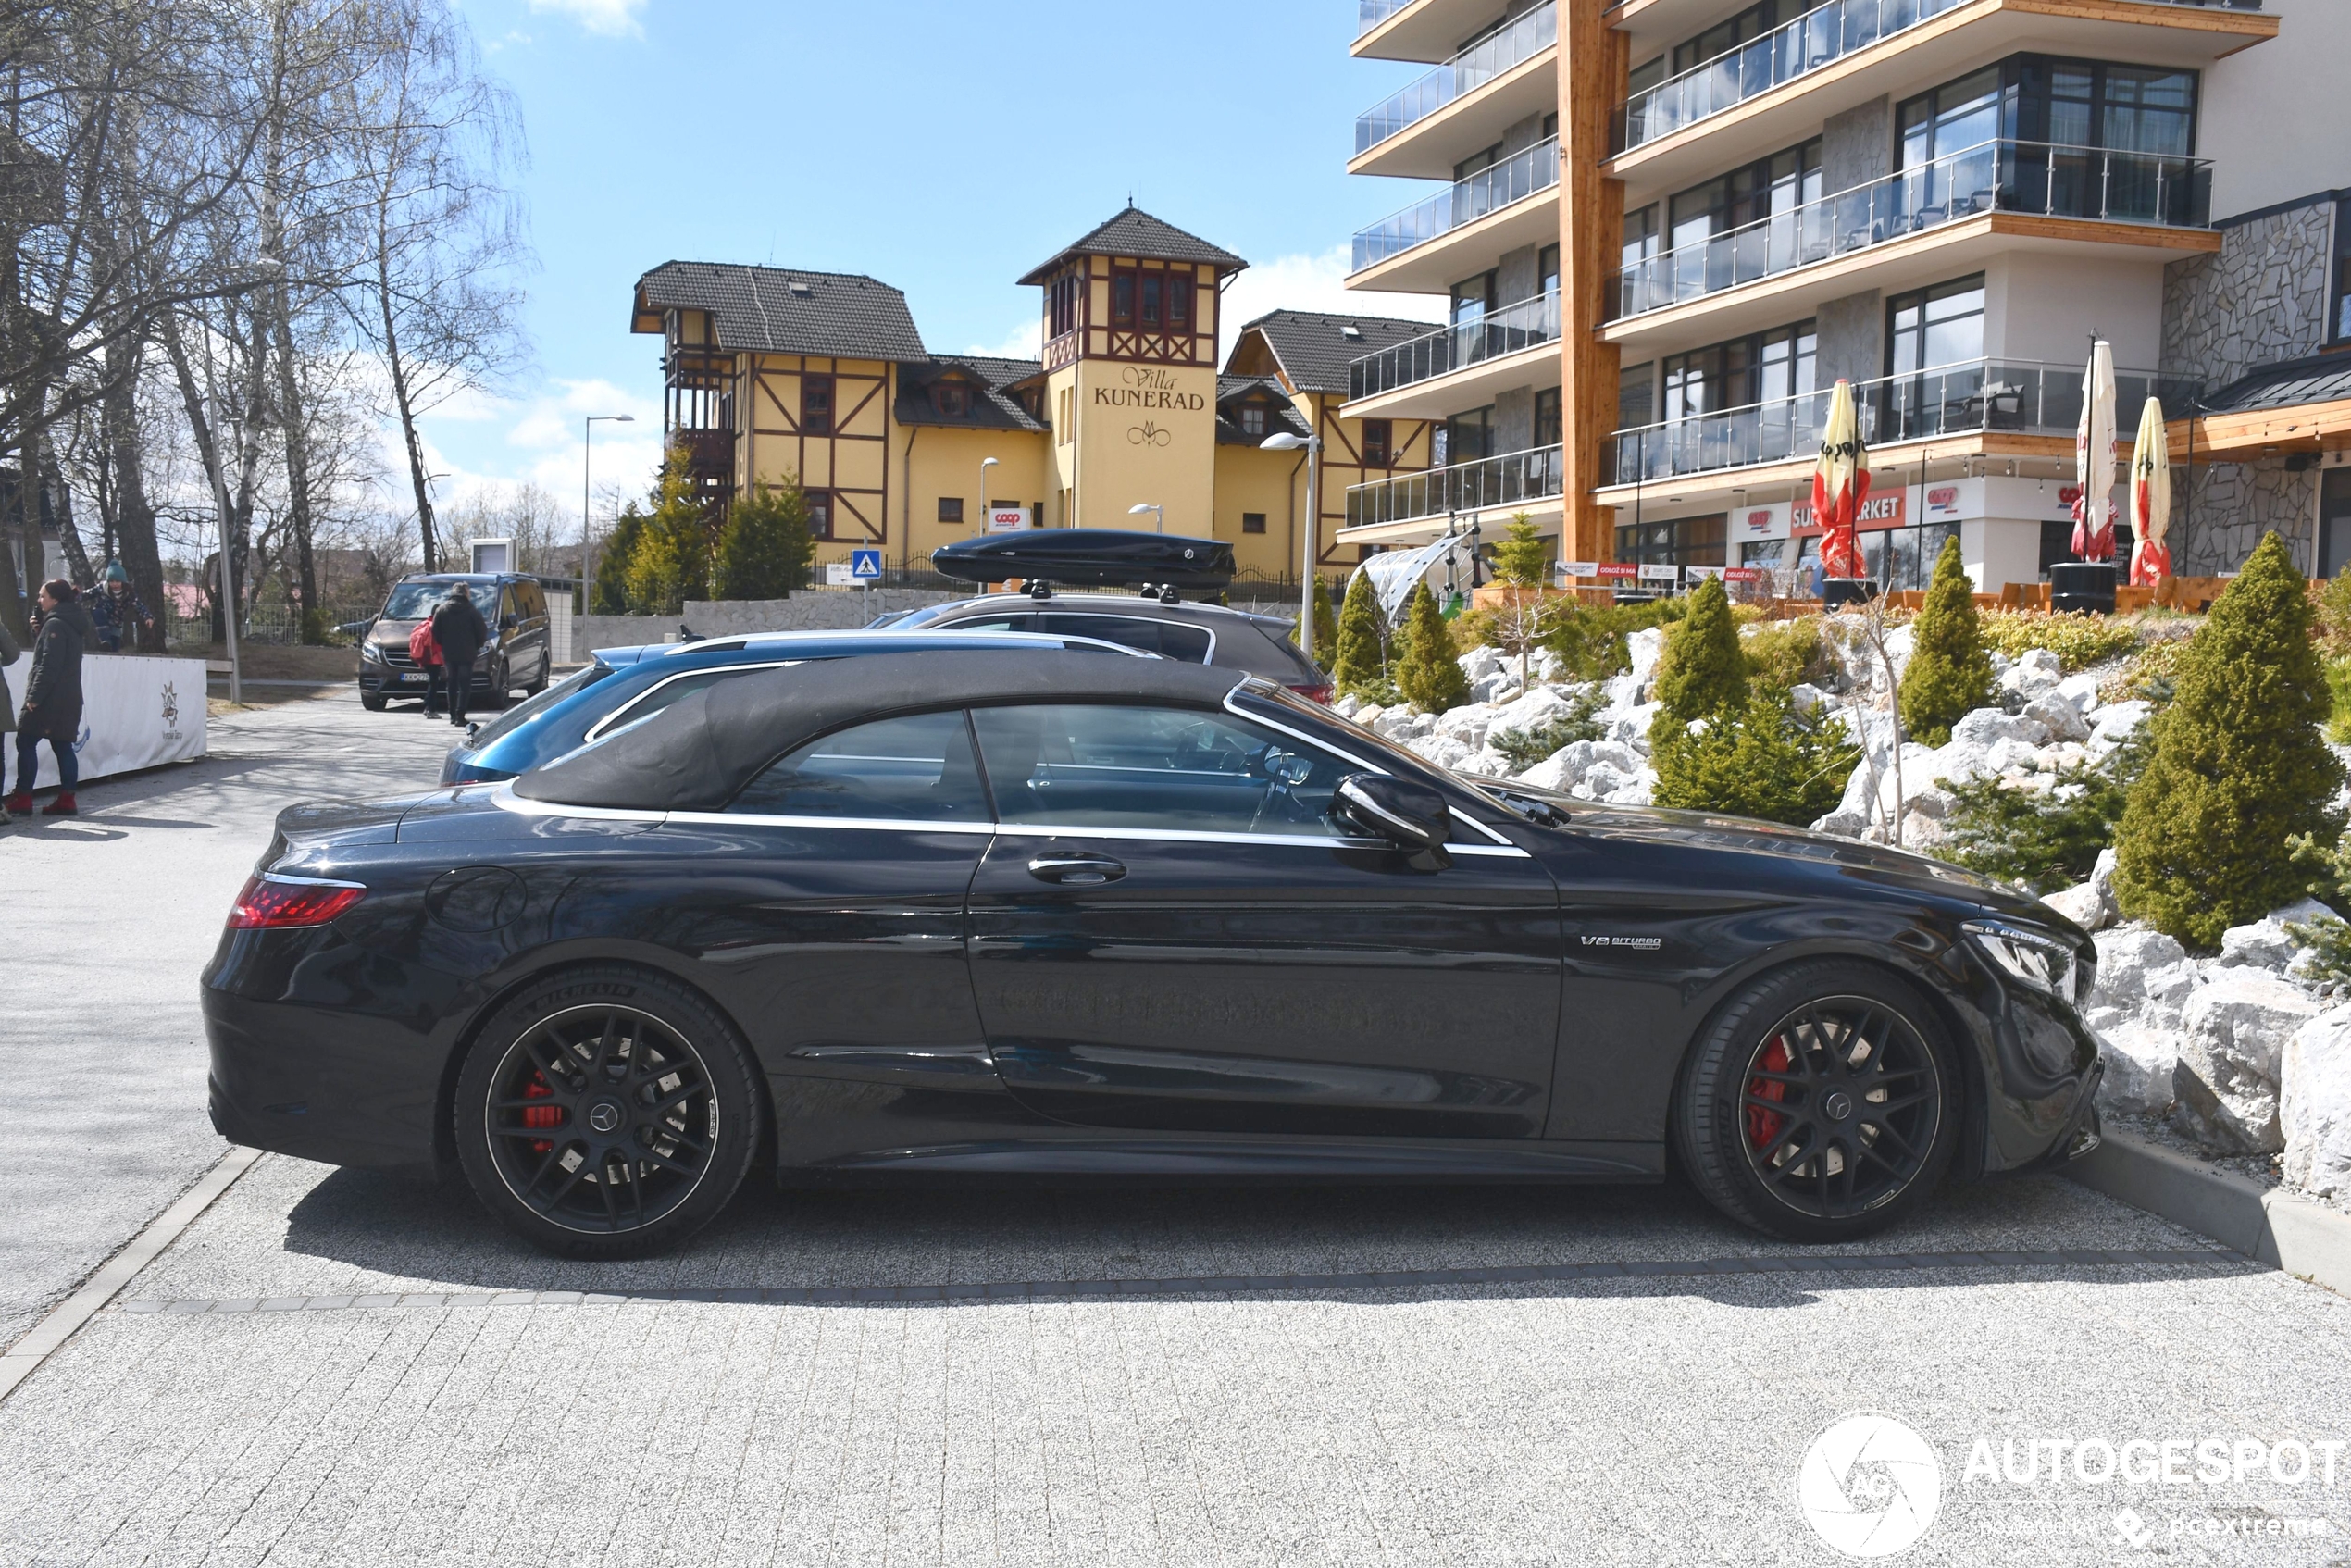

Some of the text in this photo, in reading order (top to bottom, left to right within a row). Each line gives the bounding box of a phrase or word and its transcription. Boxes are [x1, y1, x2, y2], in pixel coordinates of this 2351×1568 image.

[1122, 366, 1178, 390] Villa
[1094, 387, 1205, 411] KUNERAD
[995, 514, 1020, 526] coop
[1793, 497, 1898, 528] SURKET
[1600, 566, 1620, 575] ODLOŽ
[1581, 936, 1661, 945] V8 BITURBO
[535, 983, 631, 1007] MICHELIN
